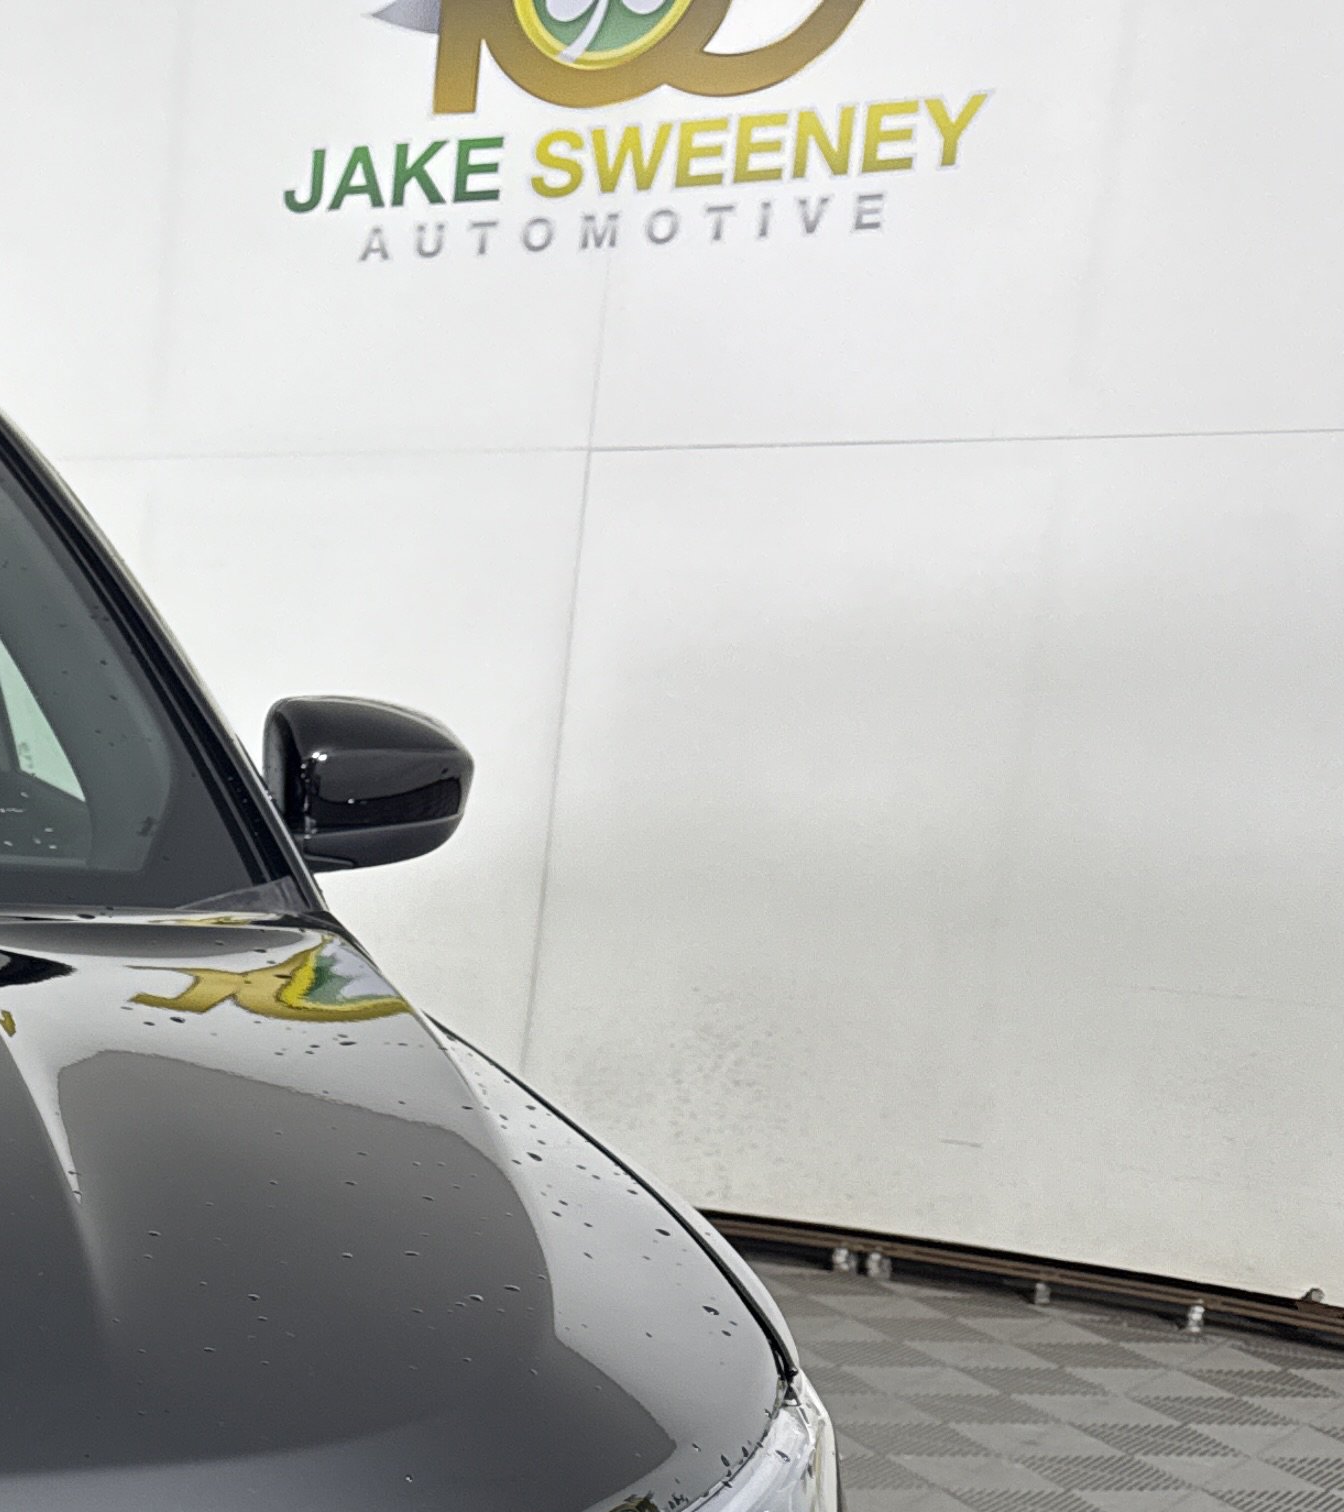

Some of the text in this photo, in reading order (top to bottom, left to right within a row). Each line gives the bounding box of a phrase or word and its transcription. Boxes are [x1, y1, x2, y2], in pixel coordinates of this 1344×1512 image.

[283, 94, 987, 214] JAKE SWEENEY
[359, 194, 887, 263] AUTOMOTIVE
